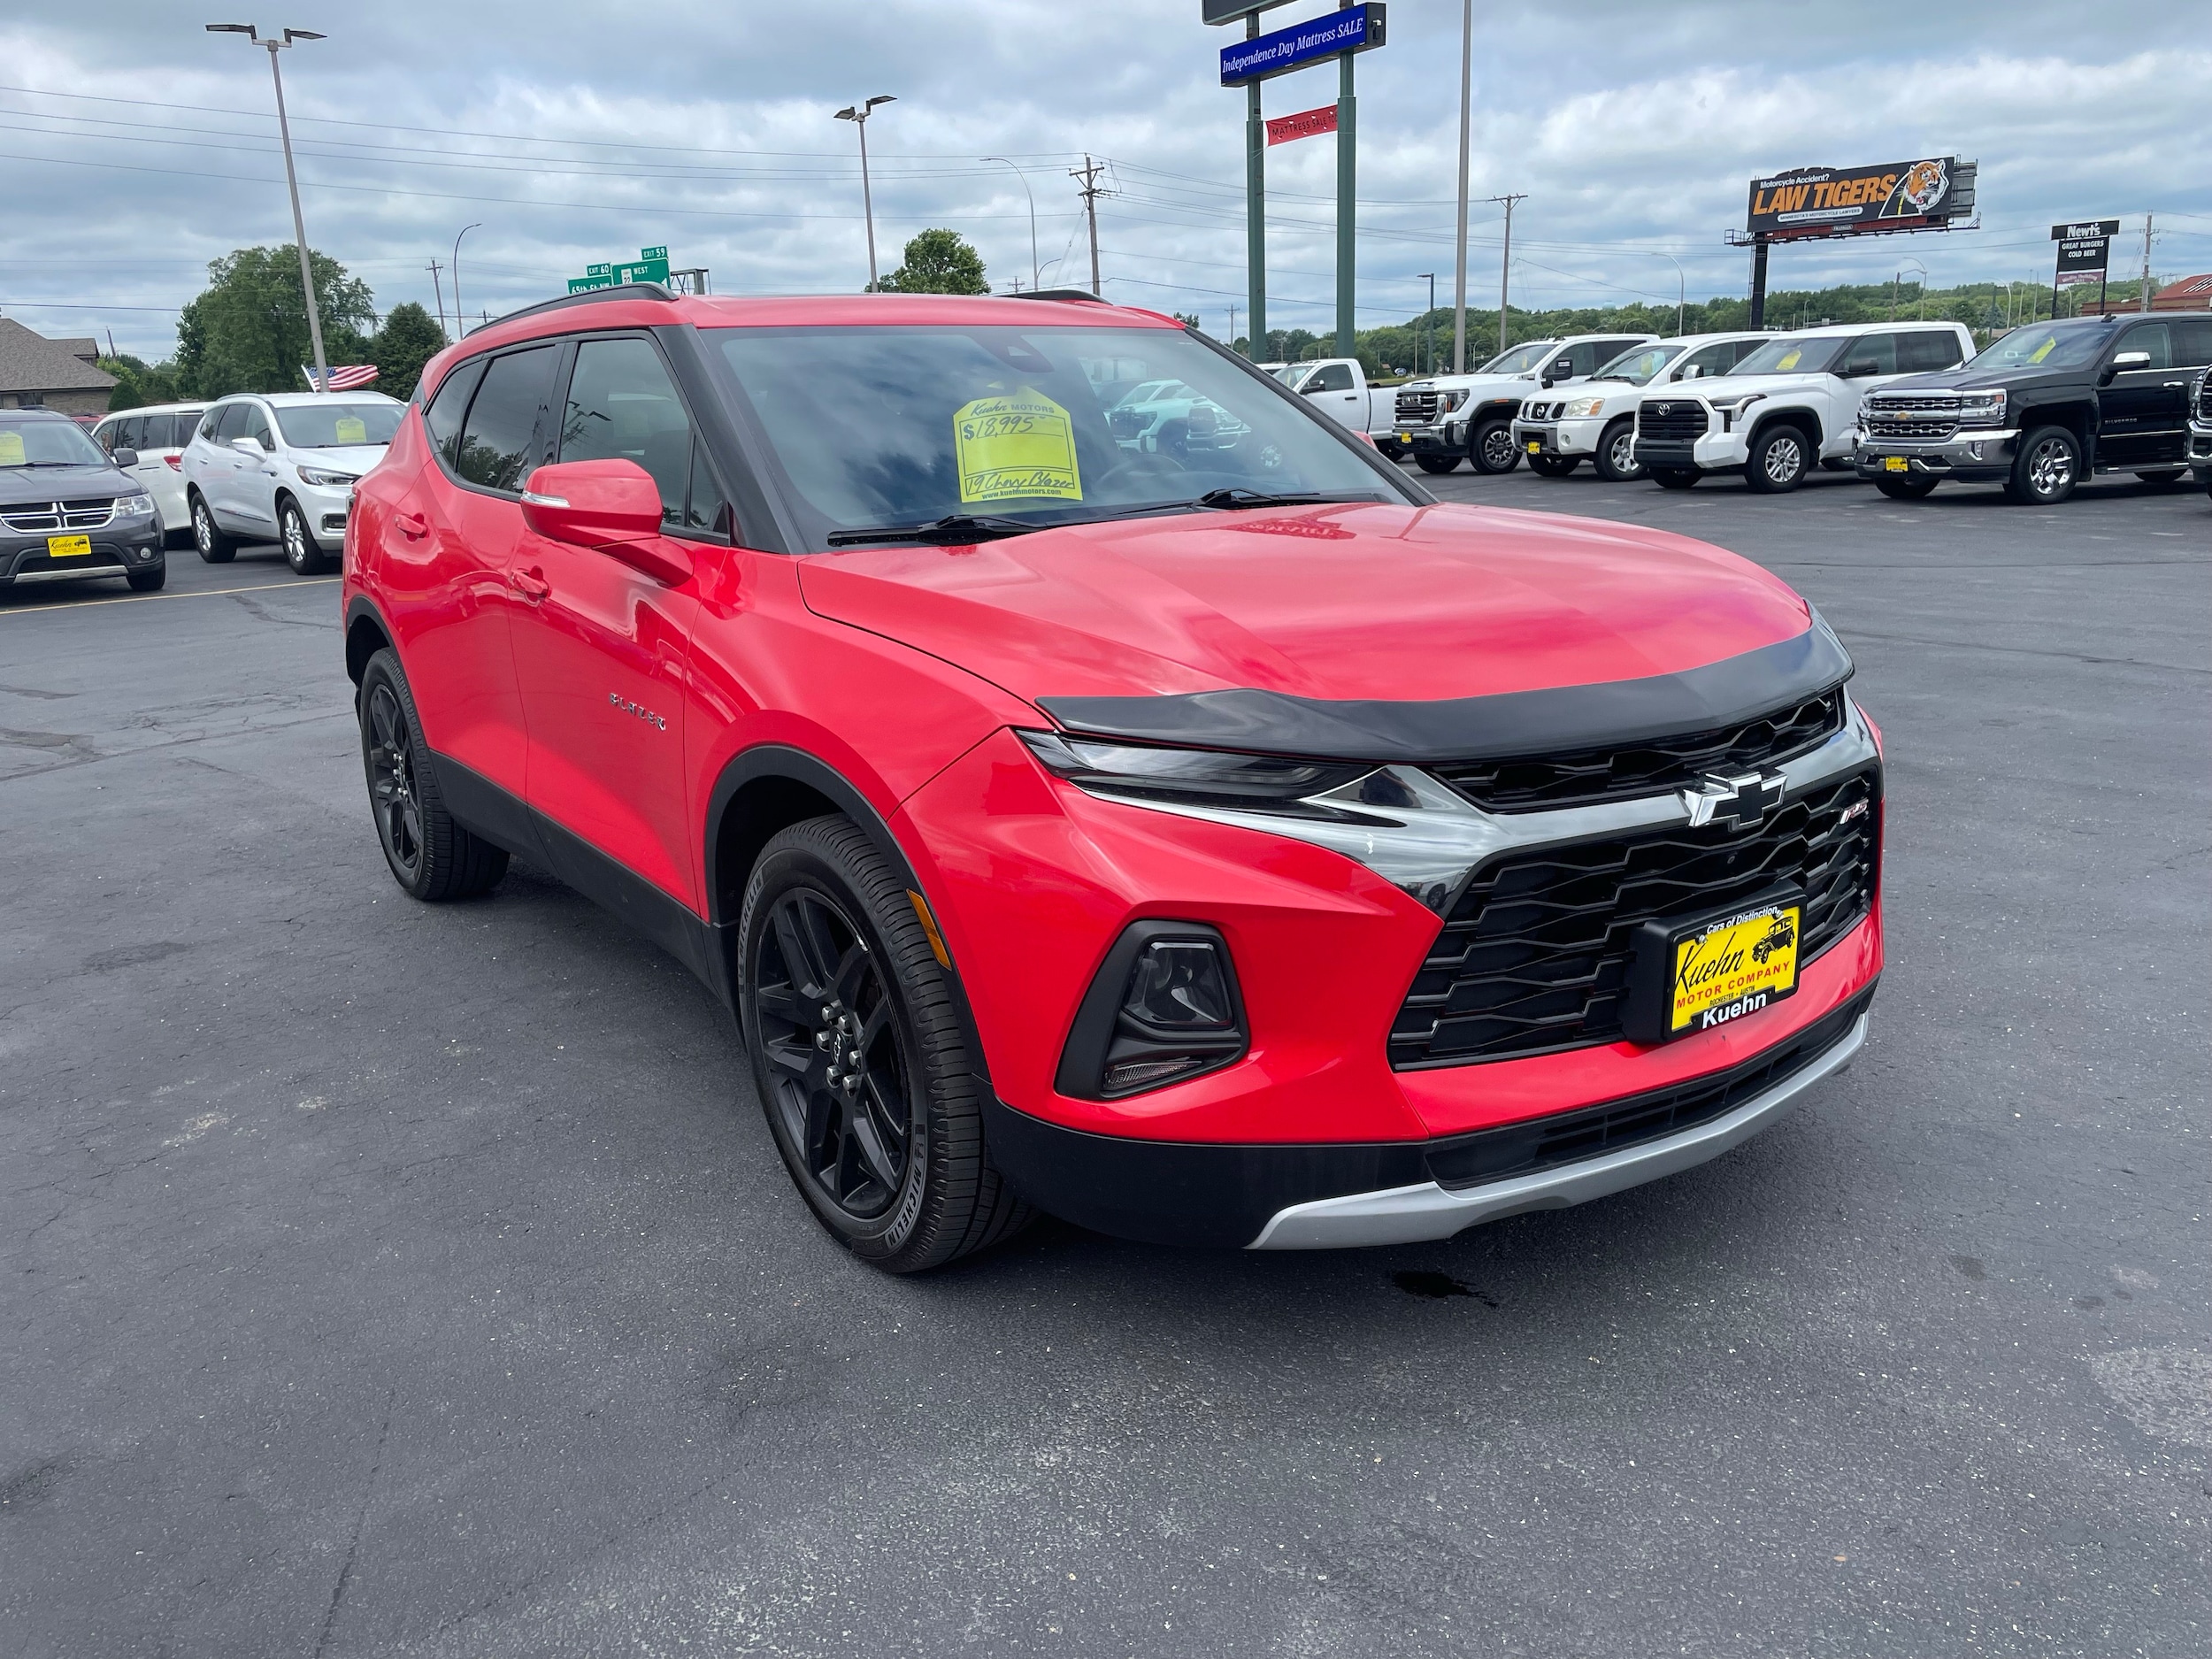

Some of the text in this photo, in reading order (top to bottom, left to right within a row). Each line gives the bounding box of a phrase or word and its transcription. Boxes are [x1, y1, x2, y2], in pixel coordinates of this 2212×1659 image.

[1222, 17, 1363, 73] Independence Day Mattress SALE
[1272, 120, 1310, 135] MATTRESS
[1312, 116, 1326, 127] SALE
[1760, 173, 1830, 189] Motorcycle Accident?
[1753, 173, 1896, 215] LAW TIGERS
[2066, 223, 2101, 238] Newt's
[656, 248, 665, 257] 59
[2080, 240, 2104, 249] BURGERS
[600, 265, 610, 273] 60
[634, 266, 649, 275] WEST
[971, 401, 1055, 417] Kuehn MOTORS
[985, 472, 1026, 491] Chevy
[1028, 471, 1073, 488] Blazer
[982, 488, 1062, 499] www.kuehnmotors.com
[610, 692, 666, 732] BLAZER
[740, 874, 762, 958] MICHELIN
[1707, 905, 1778, 934] Cars of Distinction
[1675, 931, 1745, 995] Kuehn
[1677, 961, 1790, 1010] MOTOR COMPANY
[1709, 985, 1755, 1007] ROCHESTER AUSTIN
[1701, 992, 1767, 1030] Kuehn
[887, 1164, 922, 1248] MICHELIN
